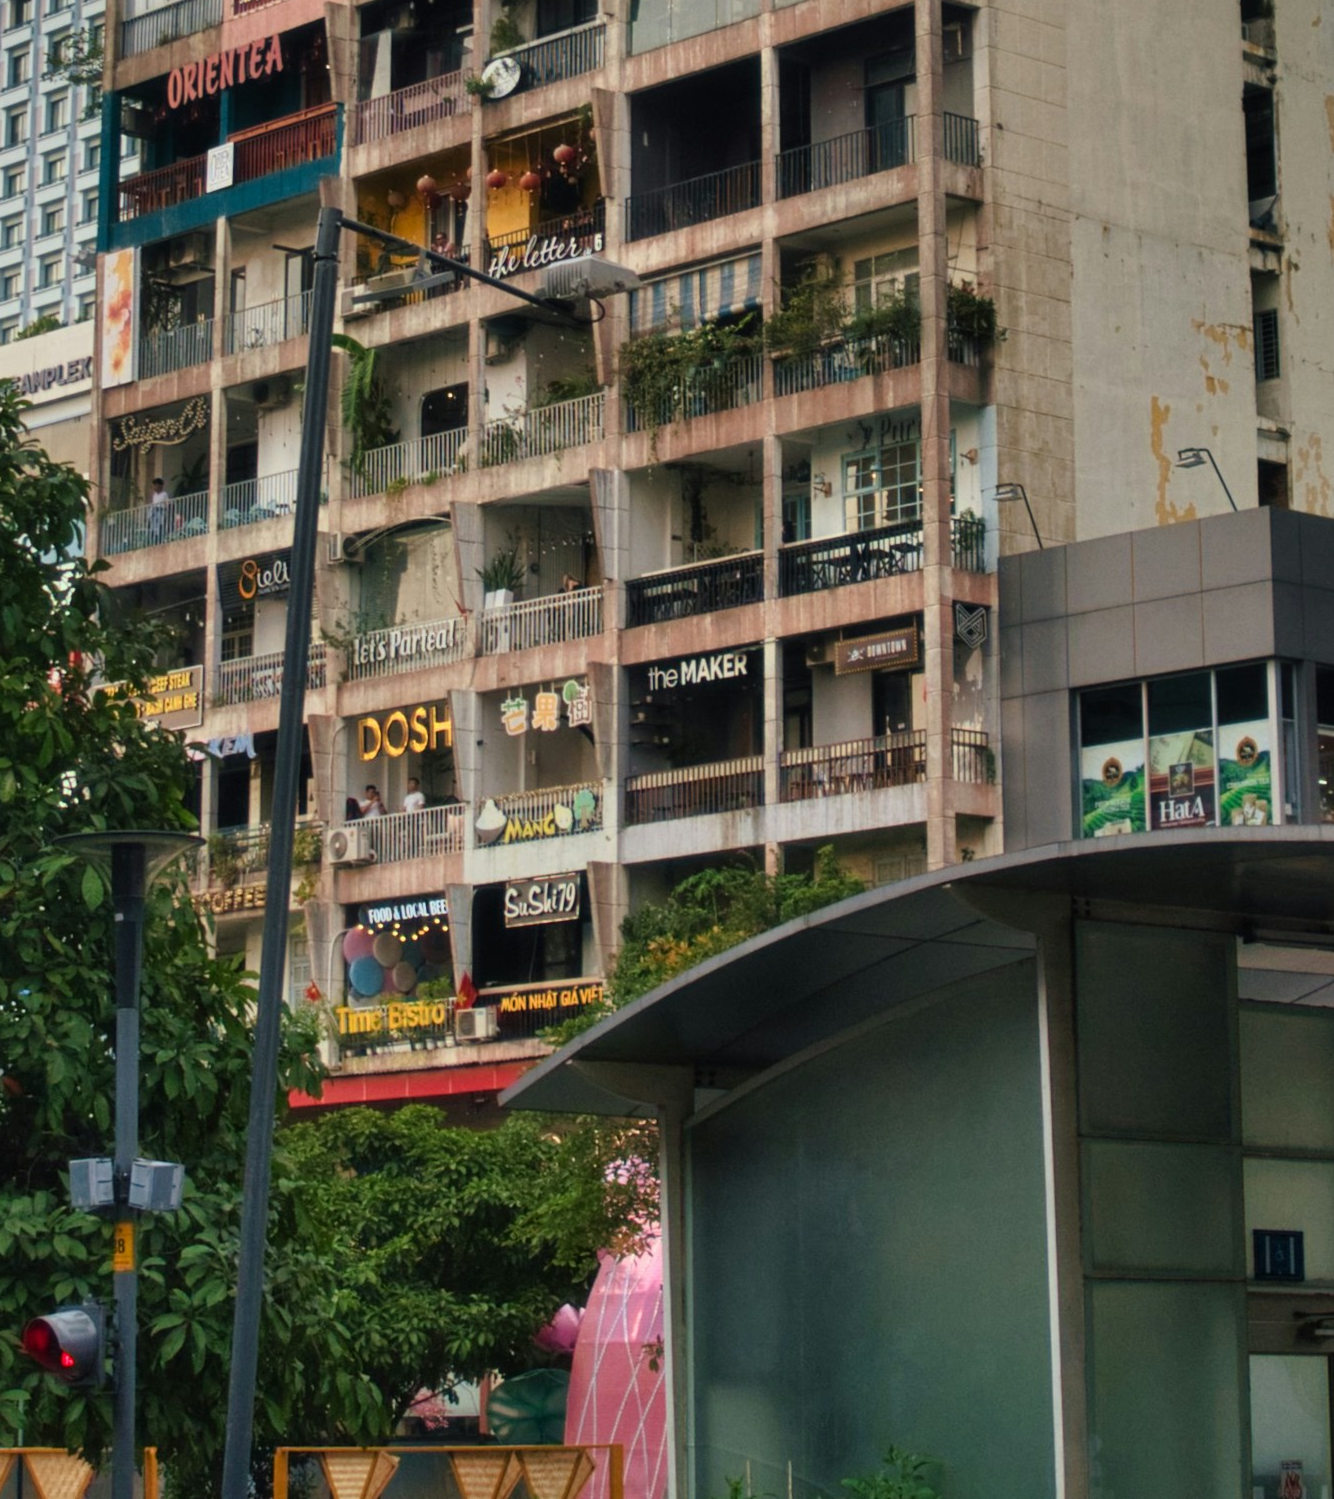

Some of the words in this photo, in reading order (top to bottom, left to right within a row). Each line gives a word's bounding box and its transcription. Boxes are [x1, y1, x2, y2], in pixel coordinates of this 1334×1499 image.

[167, 34, 284, 110] ORIENTEA
[488, 245, 521, 279] the
[523, 234, 582, 269] letter
[169, 671, 192, 691] STEAK
[648, 667, 678, 691] the
[680, 654, 747, 686] MAKER
[358, 706, 453, 761] DOSH
[368, 906, 392, 925] FOOD
[393, 906, 401, 920] &
[401, 901, 429, 920] LOCAL
[501, 992, 526, 1013] MÓN
[528, 991, 557, 1011] NHẬT
[560, 985, 579, 1007] GIÁ
[336, 1005, 383, 1034] Time
[388, 1001, 445, 1029] Bistro
